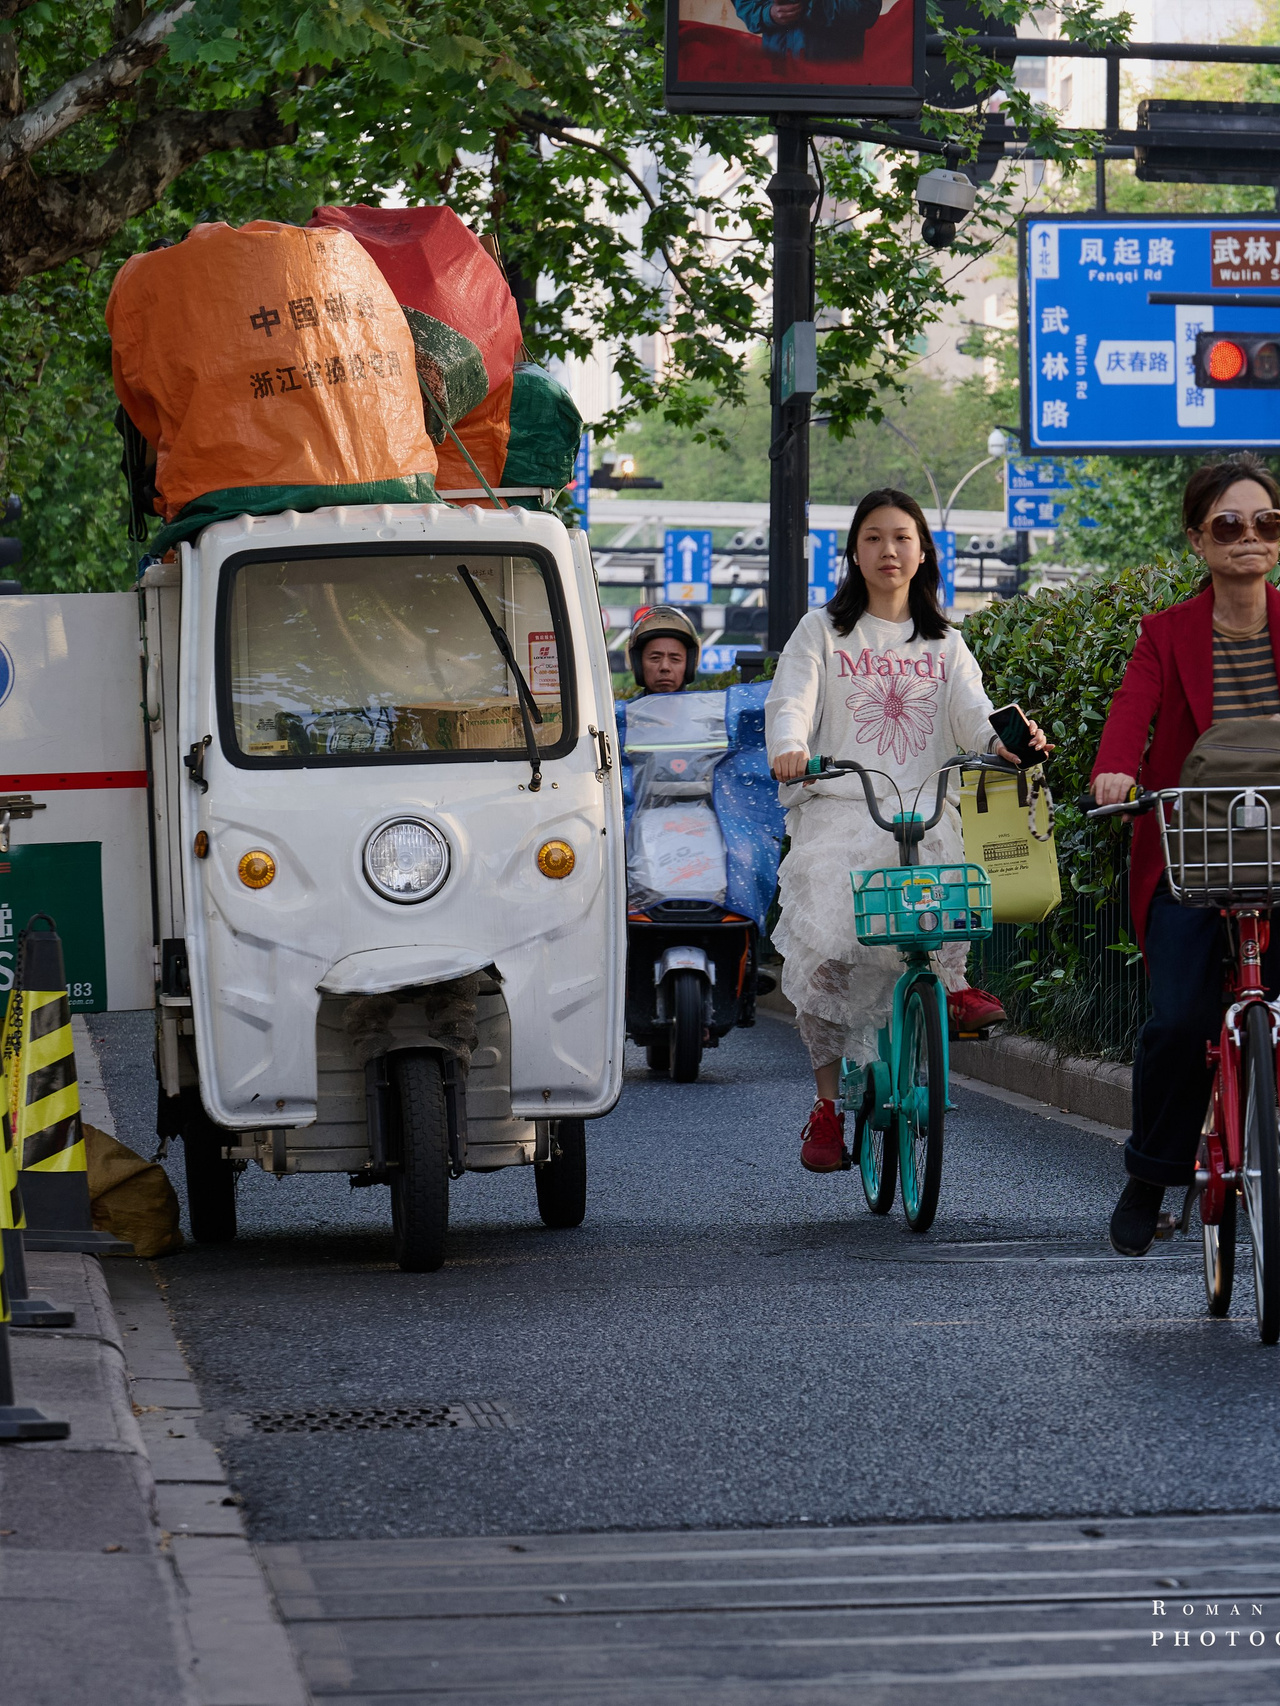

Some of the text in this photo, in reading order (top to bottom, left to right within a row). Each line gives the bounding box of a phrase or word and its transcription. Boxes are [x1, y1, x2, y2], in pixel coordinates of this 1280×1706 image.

[1038, 251, 1051, 265] 北
[1078, 237, 1176, 266] 凤起路
[1088, 268, 1163, 284] Fengqi Rd
[1219, 268, 1262, 281] Wulin
[1041, 305, 1070, 429] 武林路
[1075, 333, 1088, 400] Wulin Rd
[1106, 351, 1168, 373] 庆春路
[680, 585, 695, 599] 2
[832, 648, 948, 683] Mardi
